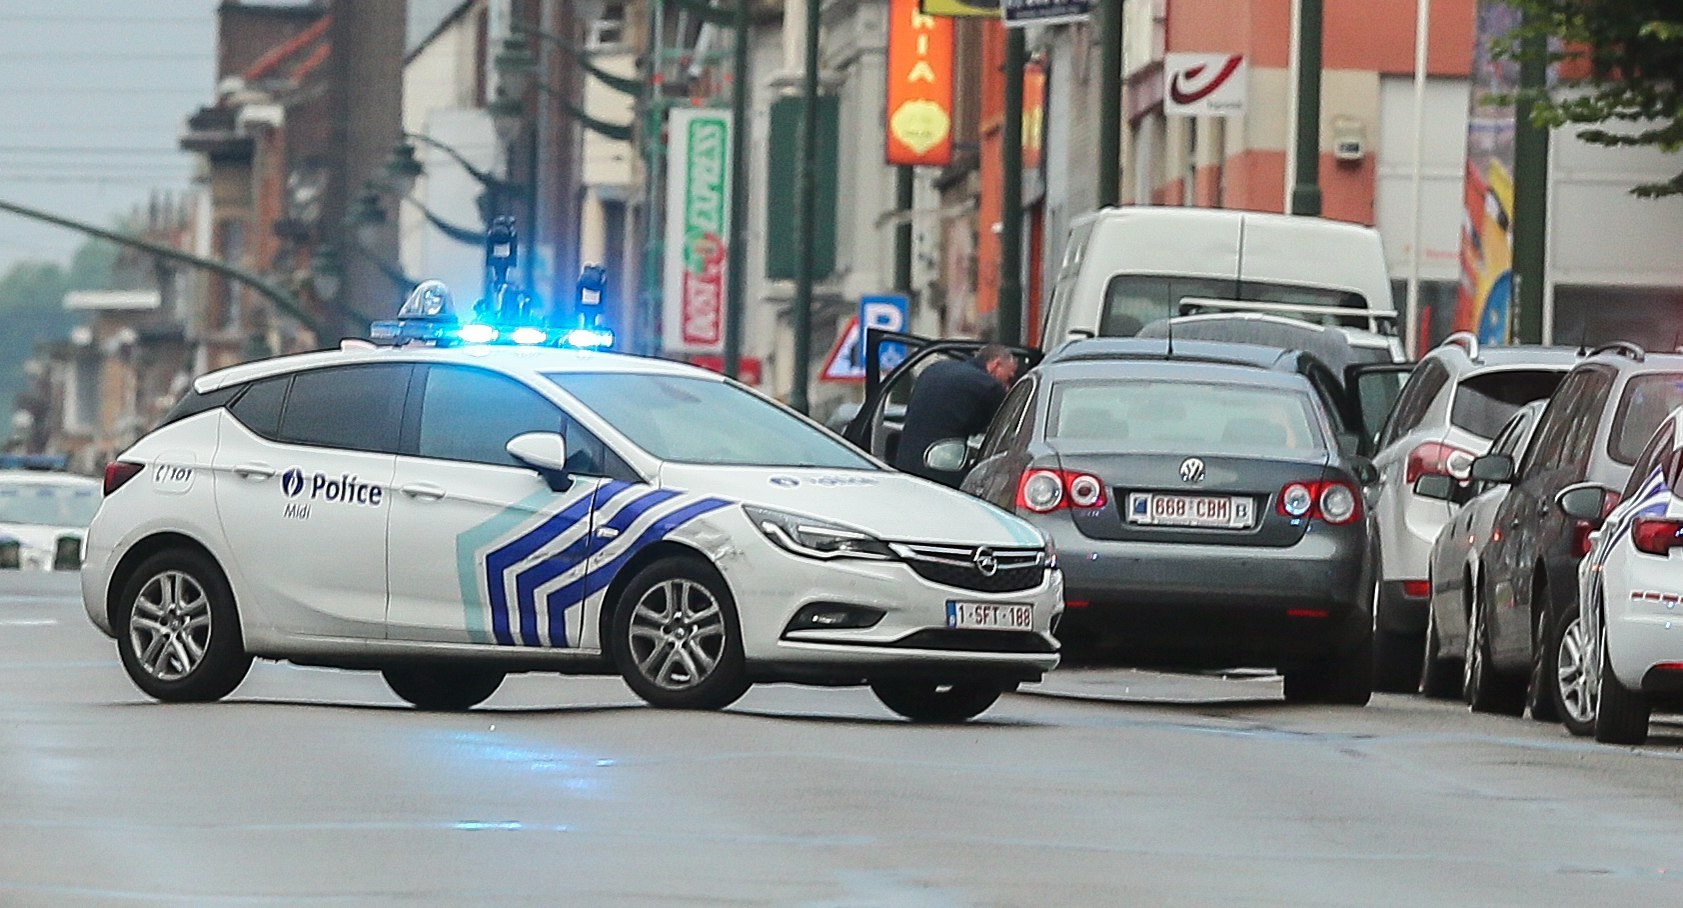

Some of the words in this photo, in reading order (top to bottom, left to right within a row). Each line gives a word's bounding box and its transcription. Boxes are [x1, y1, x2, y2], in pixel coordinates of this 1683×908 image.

[864, 303, 902, 349] P
[169, 466, 193, 482] 101
[311, 473, 382, 505] Police
[283, 503, 311, 519] Midi
